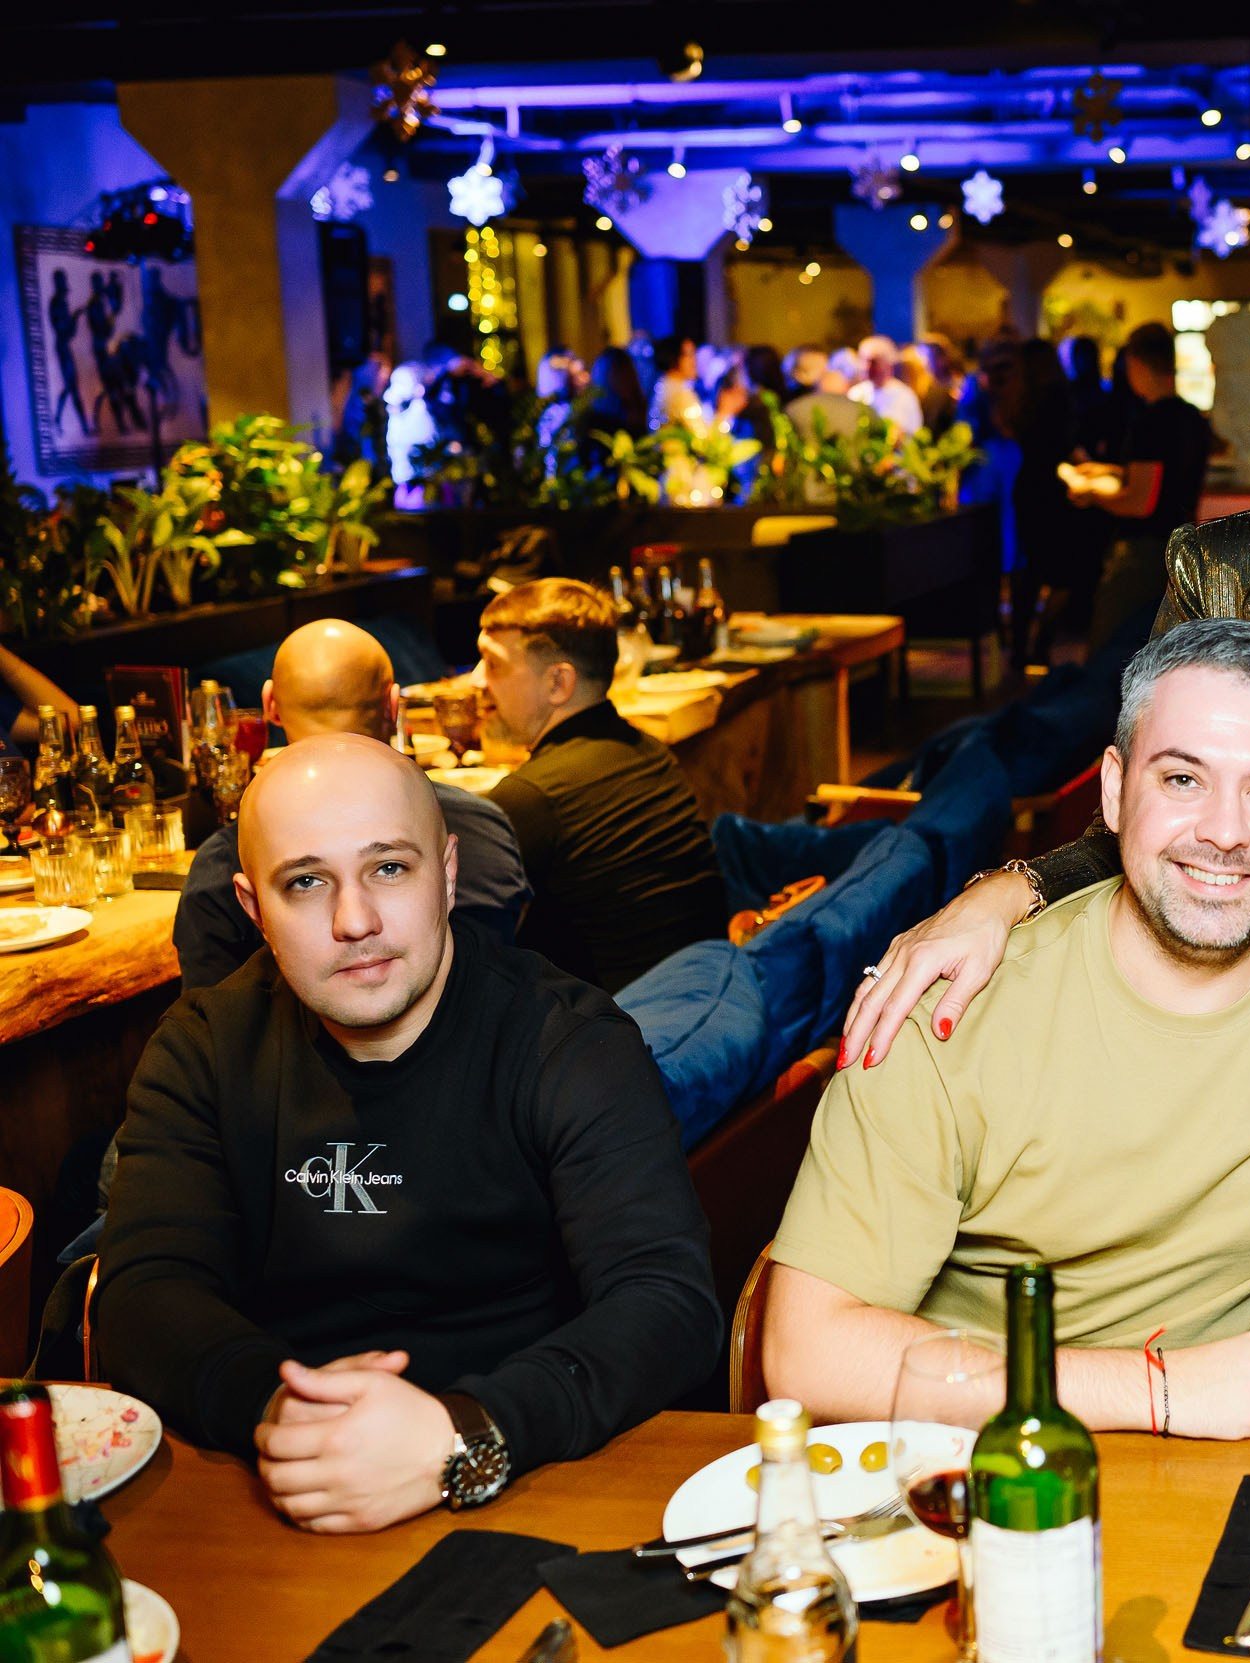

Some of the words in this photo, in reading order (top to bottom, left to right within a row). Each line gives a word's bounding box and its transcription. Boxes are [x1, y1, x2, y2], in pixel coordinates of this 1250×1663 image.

[284, 1169, 328, 1184] Calvin
[330, 1170, 363, 1185] Klein
[364, 1171, 403, 1185] Jeans
